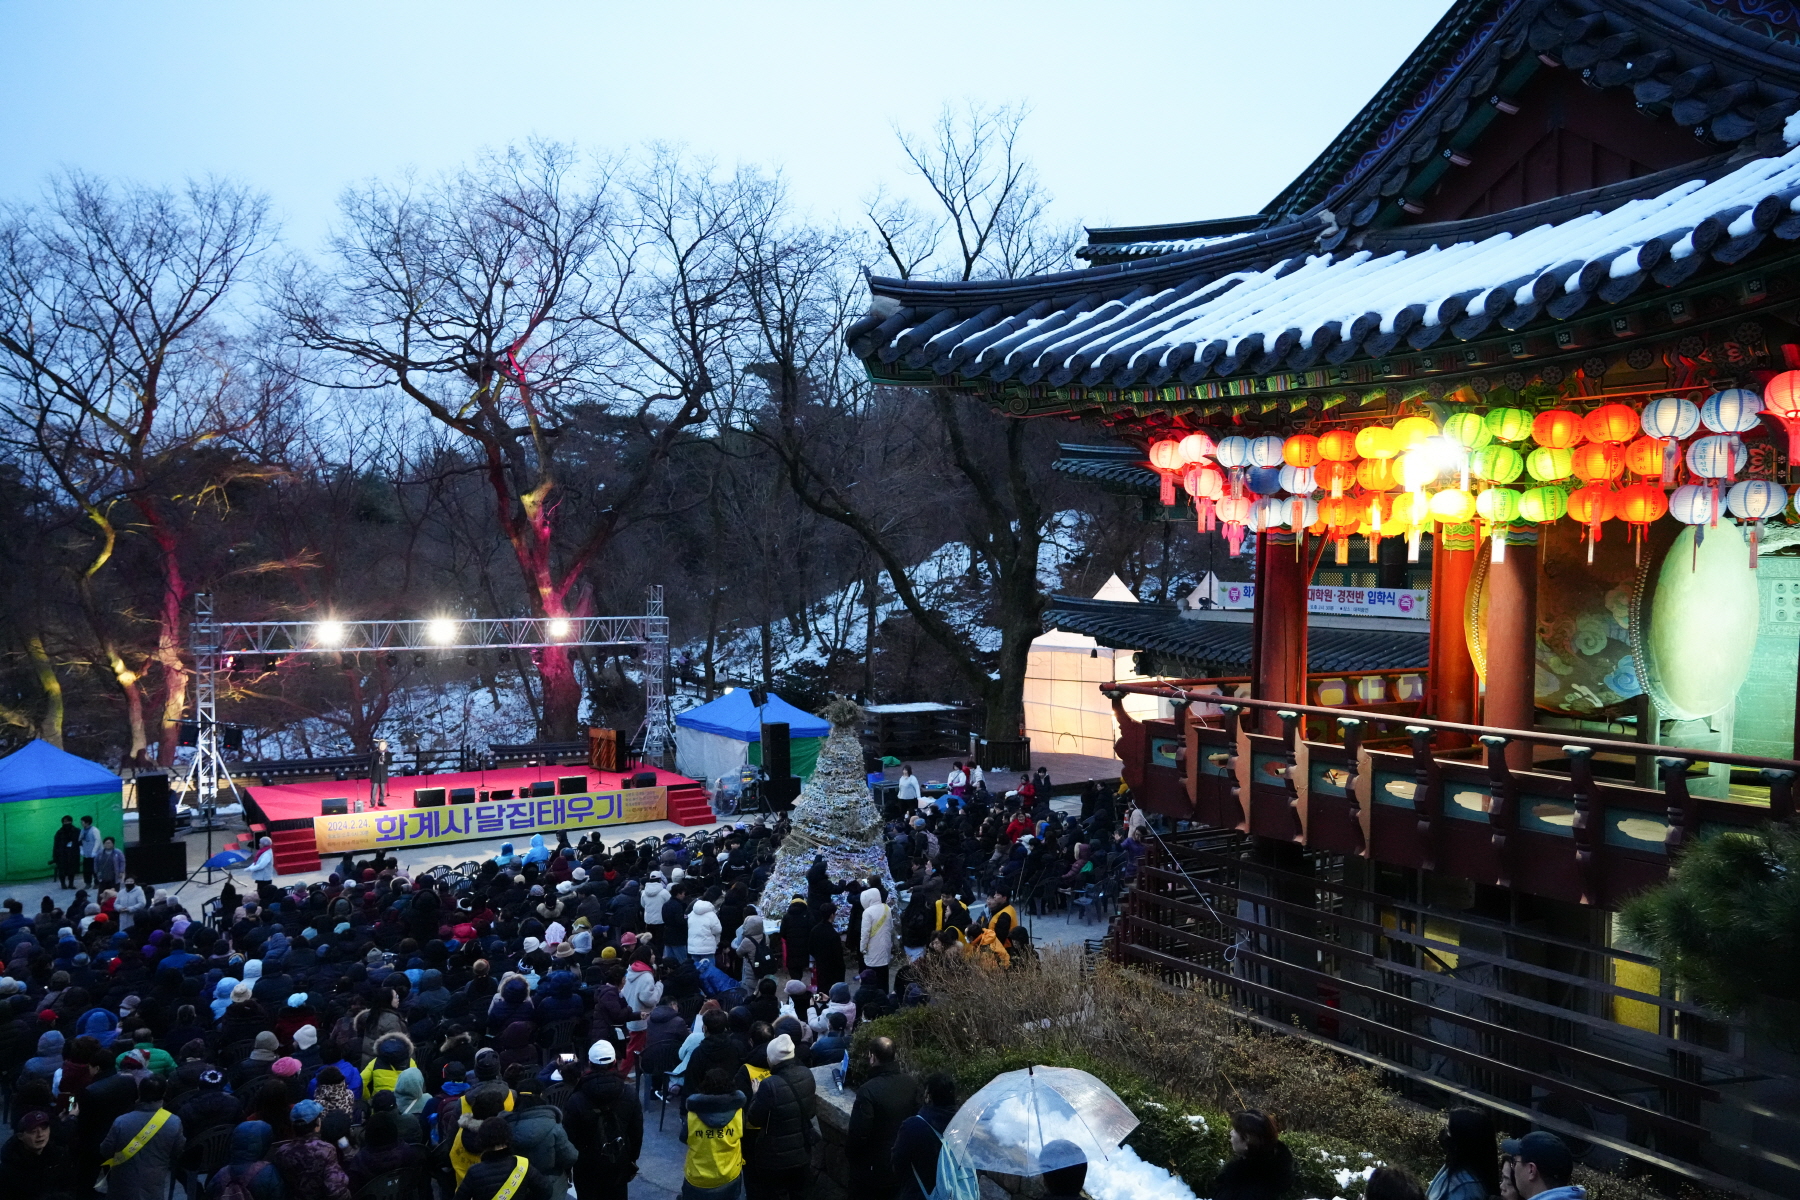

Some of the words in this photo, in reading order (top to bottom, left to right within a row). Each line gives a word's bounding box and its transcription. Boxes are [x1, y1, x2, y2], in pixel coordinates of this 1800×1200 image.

[1367, 590, 1396, 605] 입학식
[327, 819, 371, 831] 2024.2.24.
[374, 808, 473, 843] 화계사
[476, 793, 623, 832] 달집태우기
